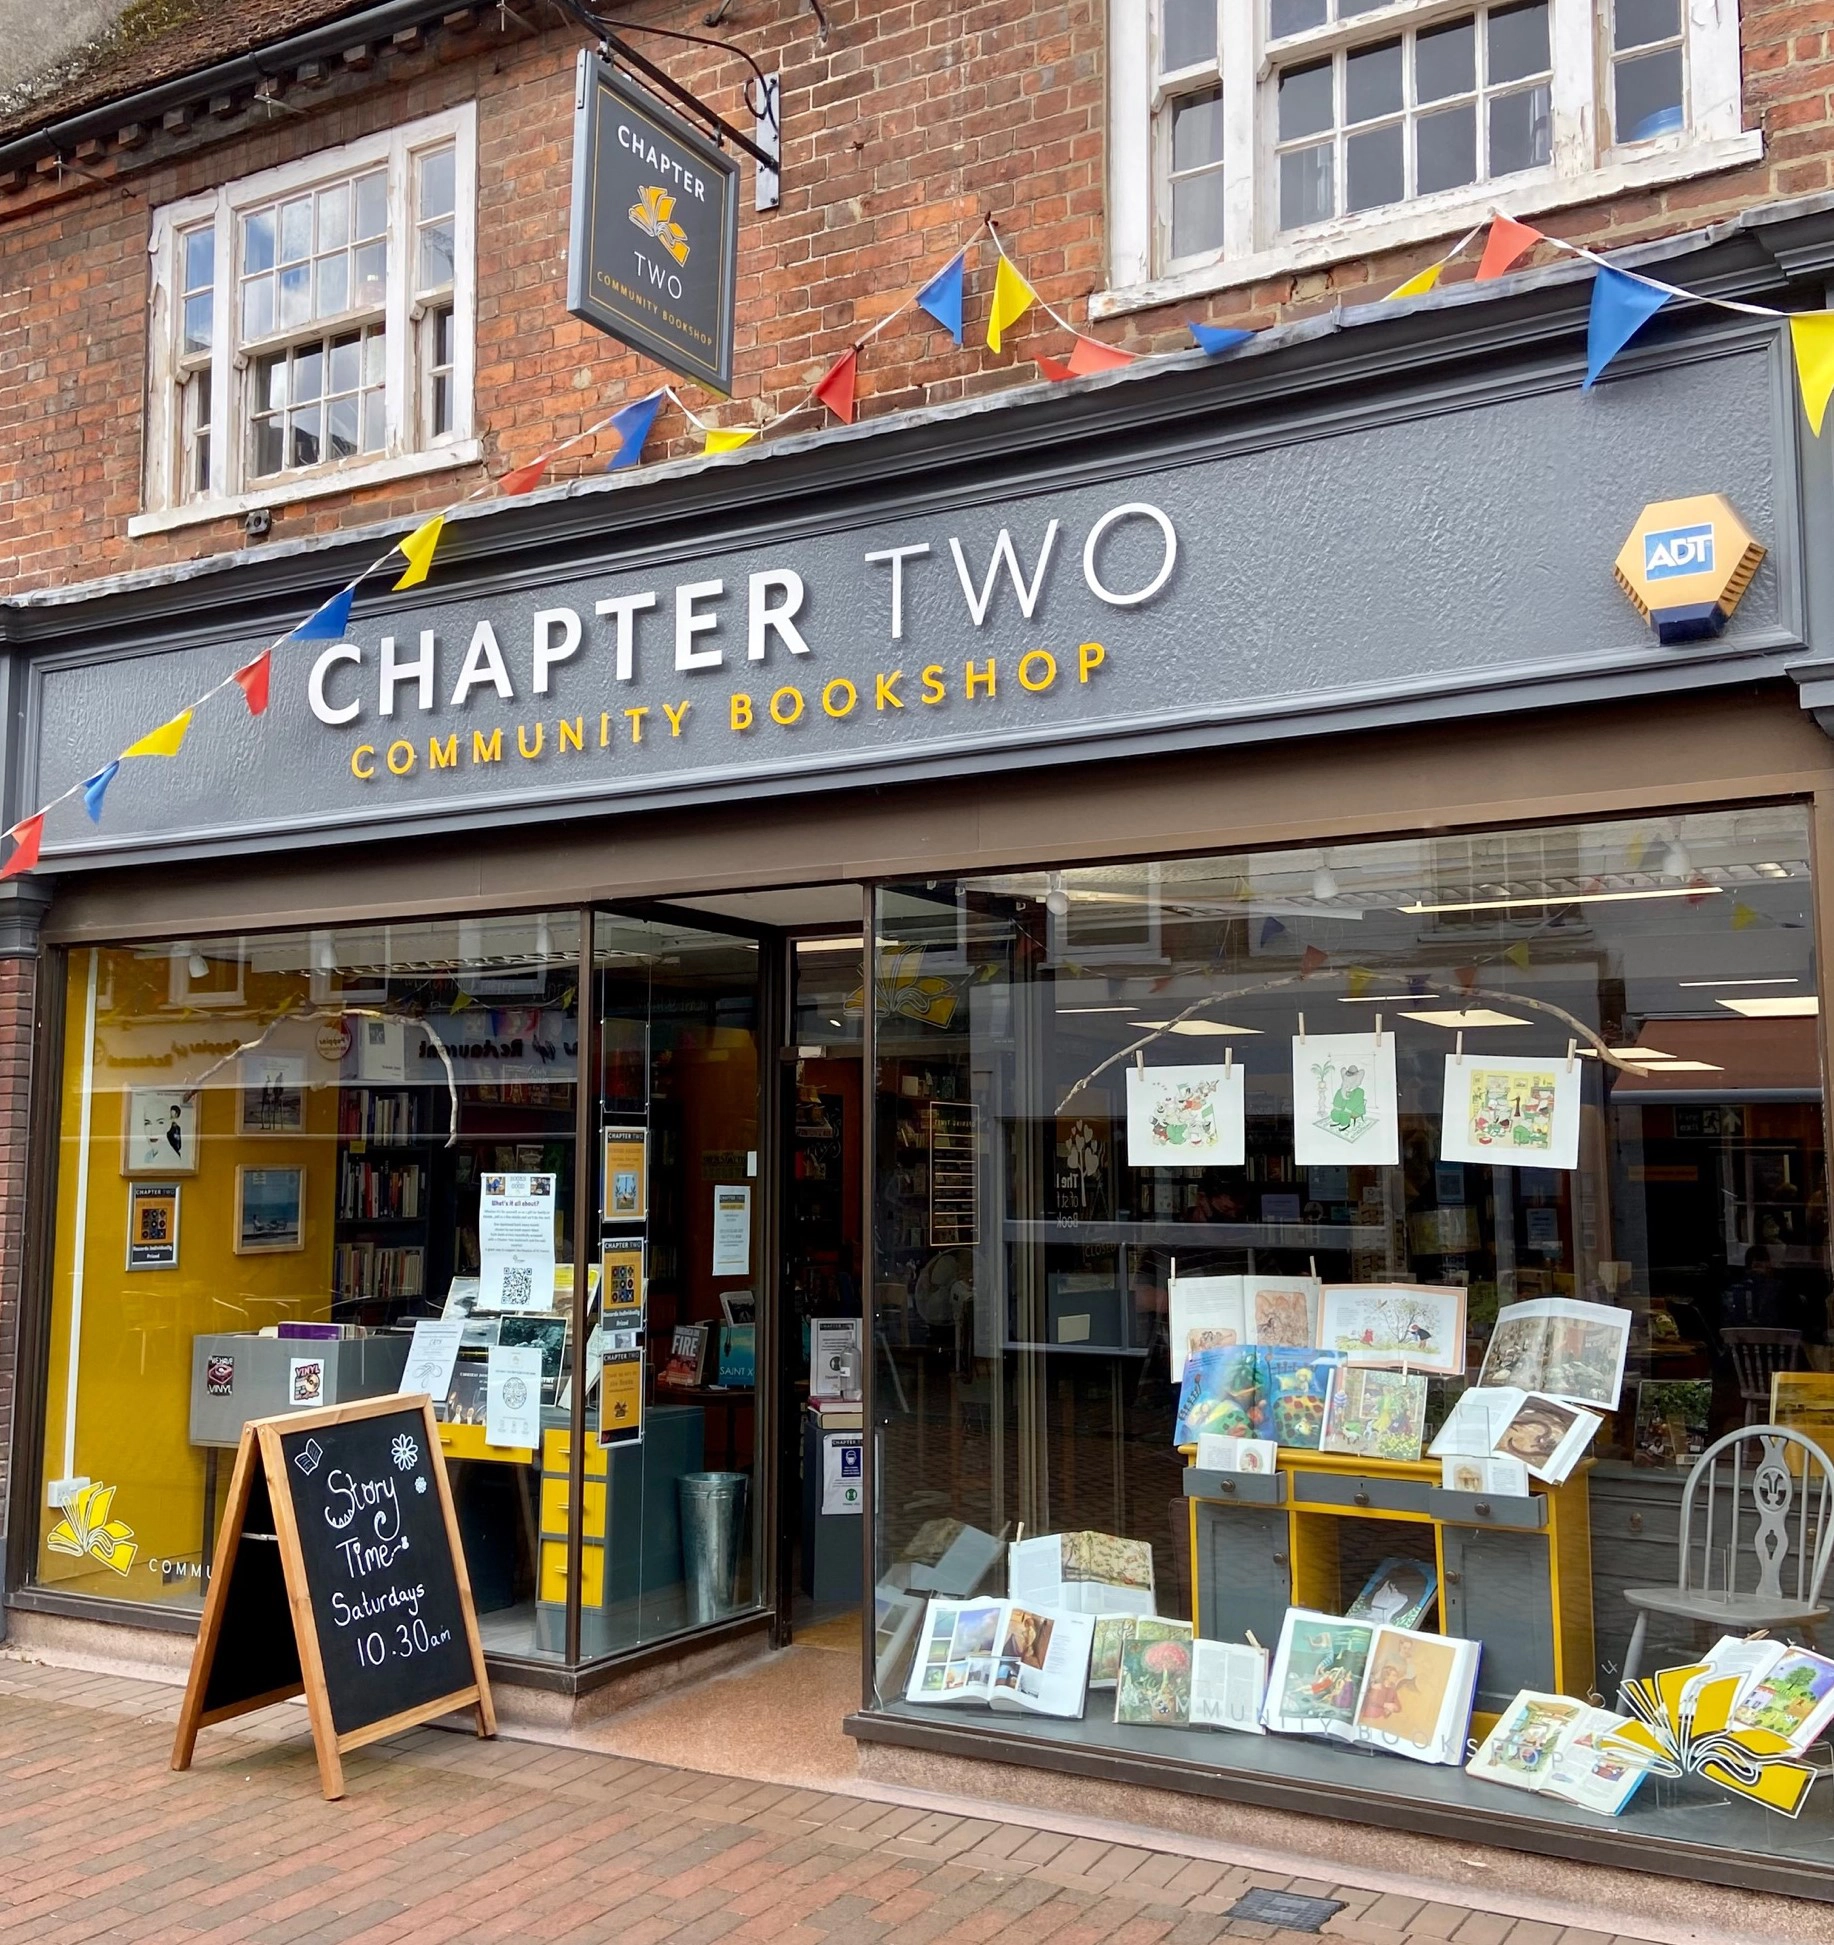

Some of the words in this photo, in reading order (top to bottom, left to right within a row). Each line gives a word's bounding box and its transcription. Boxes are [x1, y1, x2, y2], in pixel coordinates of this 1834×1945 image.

[617, 125, 705, 202] CHAPTER
[633, 250, 682, 299] TWO
[597, 271, 658, 315] COMMUNITY
[662, 310, 713, 346] BOOKSHOP
[1646, 533, 1713, 571] ADT
[308, 567, 811, 725] CHAPTER
[864, 502, 1178, 639] TWO
[350, 700, 692, 779] COMMUNITY
[730, 642, 1106, 731] BOOKSHOP
[604, 1241, 629, 1249] CHAPTER
[603, 1353, 628, 1361] CHAPTER
[671, 1335, 699, 1357] FIRE
[209, 1384, 233, 1394] VINYL
[296, 1364, 320, 1377] VINYL
[720, 1366, 746, 1376] SAINT
[747, 1367, 754, 1377] X
[324, 1469, 400, 1542] Story
[335, 1537, 395, 1579] Time
[332, 1583, 425, 1627] Saturdays
